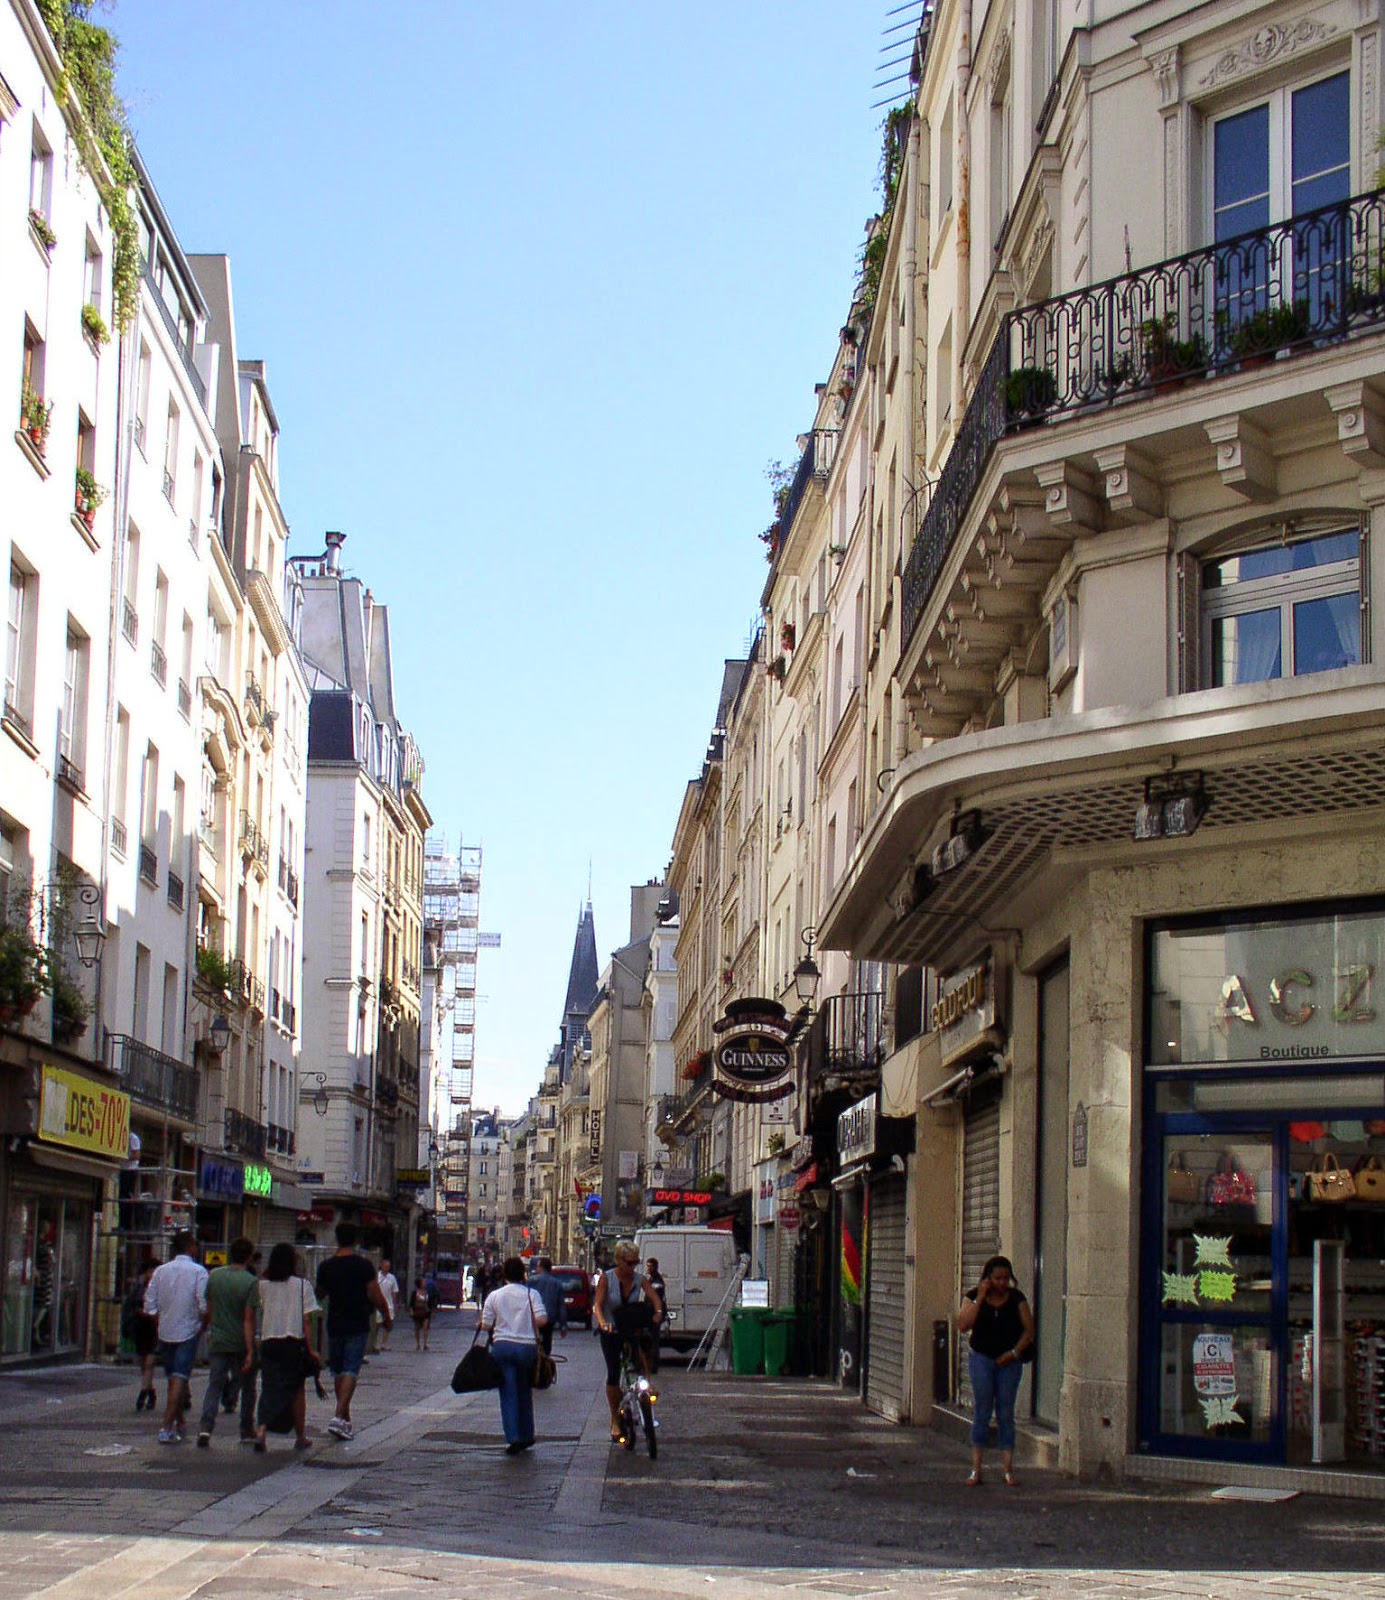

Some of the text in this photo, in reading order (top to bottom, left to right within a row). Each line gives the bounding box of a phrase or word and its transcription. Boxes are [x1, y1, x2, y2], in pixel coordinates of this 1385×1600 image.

[721, 1049, 786, 1067] GUINNESS
[1260, 1045, 1329, 1058] Boutique
[95, 1092, 128, 1153] -70%
[591, 1110, 600, 1157] HOTEL
[684, 1192, 711, 1204] SHOP
